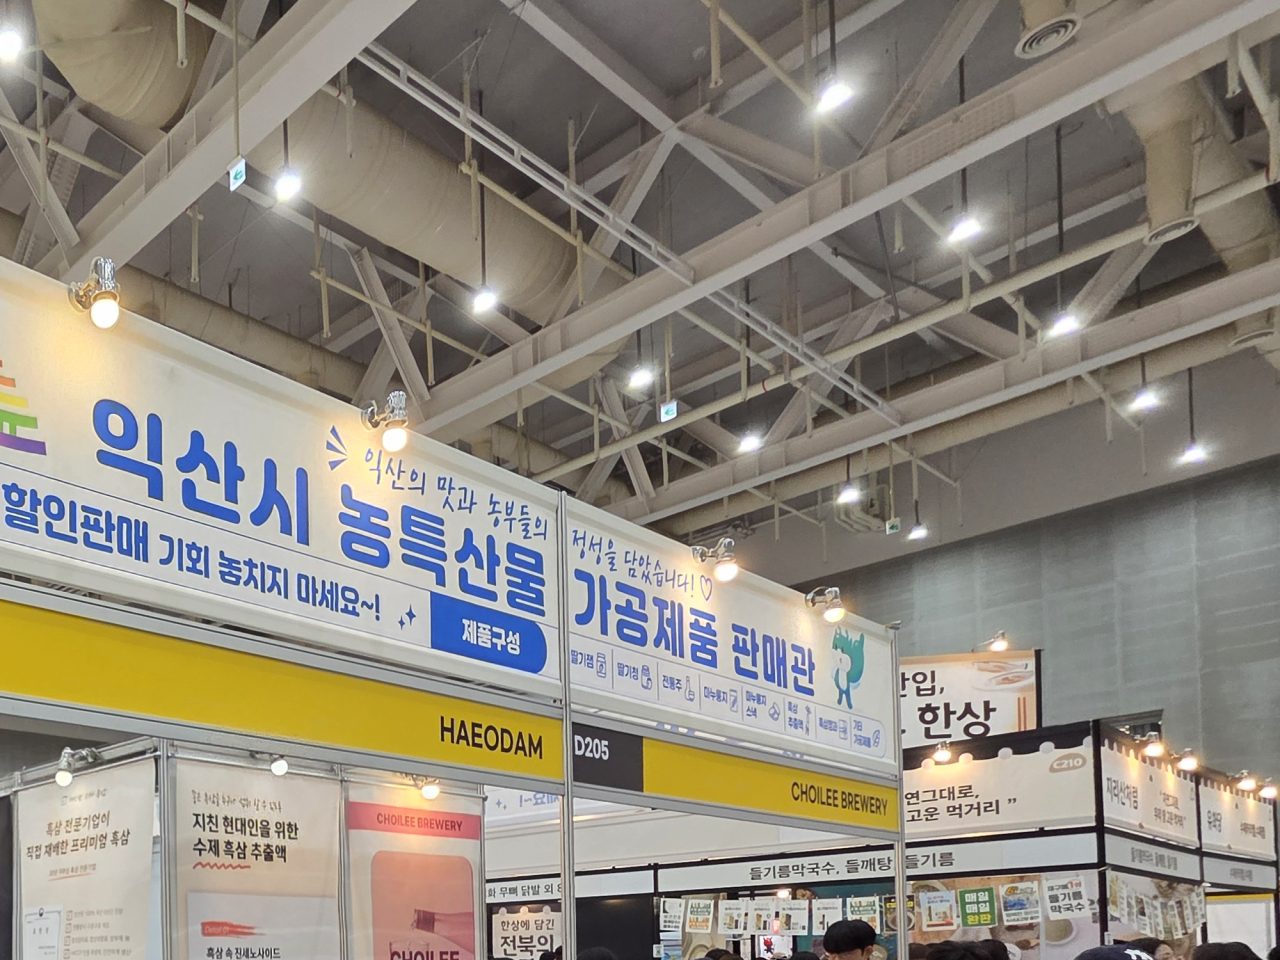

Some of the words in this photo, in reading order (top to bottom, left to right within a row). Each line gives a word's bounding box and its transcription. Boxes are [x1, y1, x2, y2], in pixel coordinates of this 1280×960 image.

[93, 399, 309, 546] 익산시
[365, 448, 426, 495] 익산의
[437, 476, 477, 513] 맛과
[488, 494, 548, 540] 농부들의
[2, 483, 149, 563] 할인판매
[159, 534, 210, 578] 기회
[218, 551, 288, 599] 놓치지
[297, 573, 380, 621] 마세요~!
[338, 483, 546, 618] 농특산물
[572, 530, 617, 571] 정성을
[624, 550, 694, 598] 담았습니다!
[462, 618, 520, 655] 제품구성
[574, 568, 718, 669] 가공제품
[732, 623, 816, 697] 판매관
[571, 650, 594, 669] 딸기잼
[617, 662, 639, 681] 딸기청
[918, 700, 997, 739] 한상
[439, 714, 544, 761] HAEODAM
[574, 731, 610, 762] D205
[1052, 757, 1083, 770] C210
[791, 782, 838, 808] CHOILEE
[841, 791, 888, 817] BREWERY
[906, 805, 940, 823] 고운
[946, 800, 999, 819] 먹거리
[46, 820, 62, 838] 흑삼
[64, 811, 110, 834] 전문기업이
[192, 812, 219, 832] 지친
[222, 816, 271, 837] 현대인을
[274, 821, 299, 840] 위한
[377, 813, 416, 828] CHOILEE
[417, 817, 463, 832] BREWERY
[26, 845, 42, 861] 직접
[44, 839, 68, 857] 재배한
[70, 834, 107, 852] 프리미엄
[110, 829, 130, 847] 흑삼
[193, 838, 219, 858] 수제
[223, 840, 247, 860] 흑삼
[250, 842, 287, 863] 추출액
[750, 863, 840, 880] 들기름막국수,
[845, 856, 892, 873] 들깨탕
[905, 852, 954, 870] 들기름
[965, 891, 989, 903] 매일
[966, 902, 990, 914] 매일
[1050, 902, 1085, 914] 막국수
[501, 919, 530, 931] 한상에
[534, 918, 555, 930] 담긴
[206, 947, 222, 959] 흑삼
[500, 935, 554, 956] 전북의
